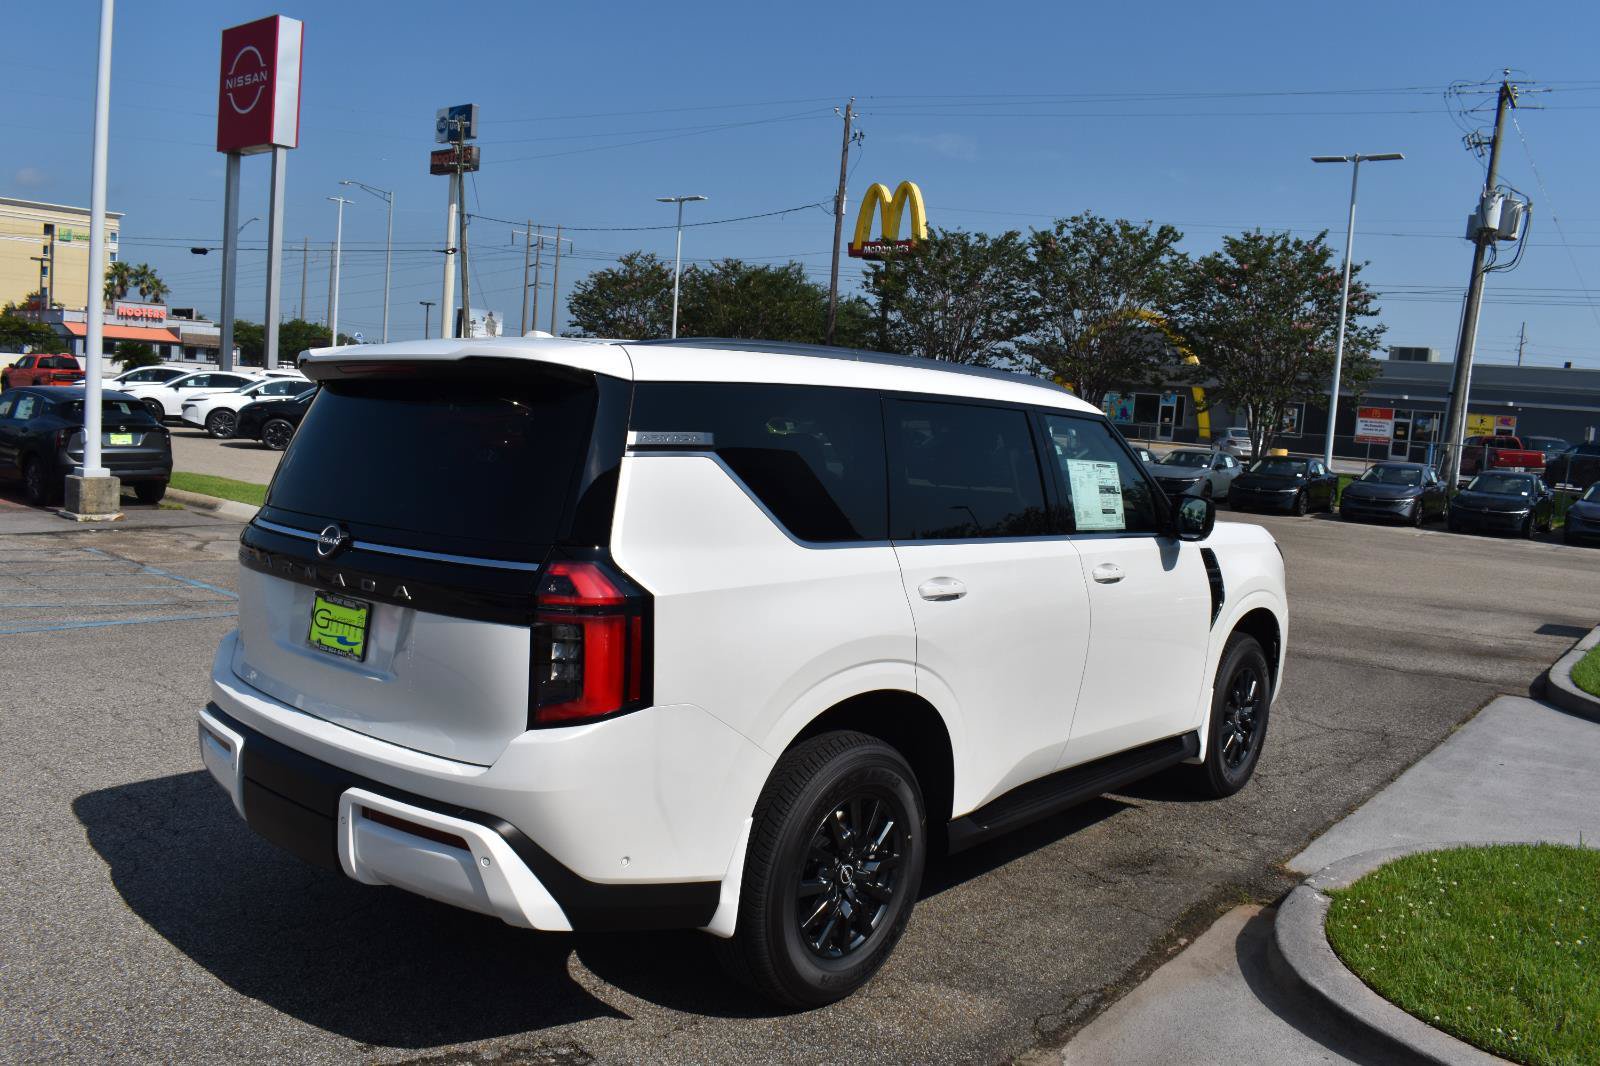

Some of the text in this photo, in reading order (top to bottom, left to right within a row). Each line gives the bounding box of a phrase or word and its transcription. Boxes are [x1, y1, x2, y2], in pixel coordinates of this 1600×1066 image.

[226, 71, 268, 89] NISSAN
[118, 305, 167, 319] HOOTERS
[264, 553, 412, 600] ARMADA
